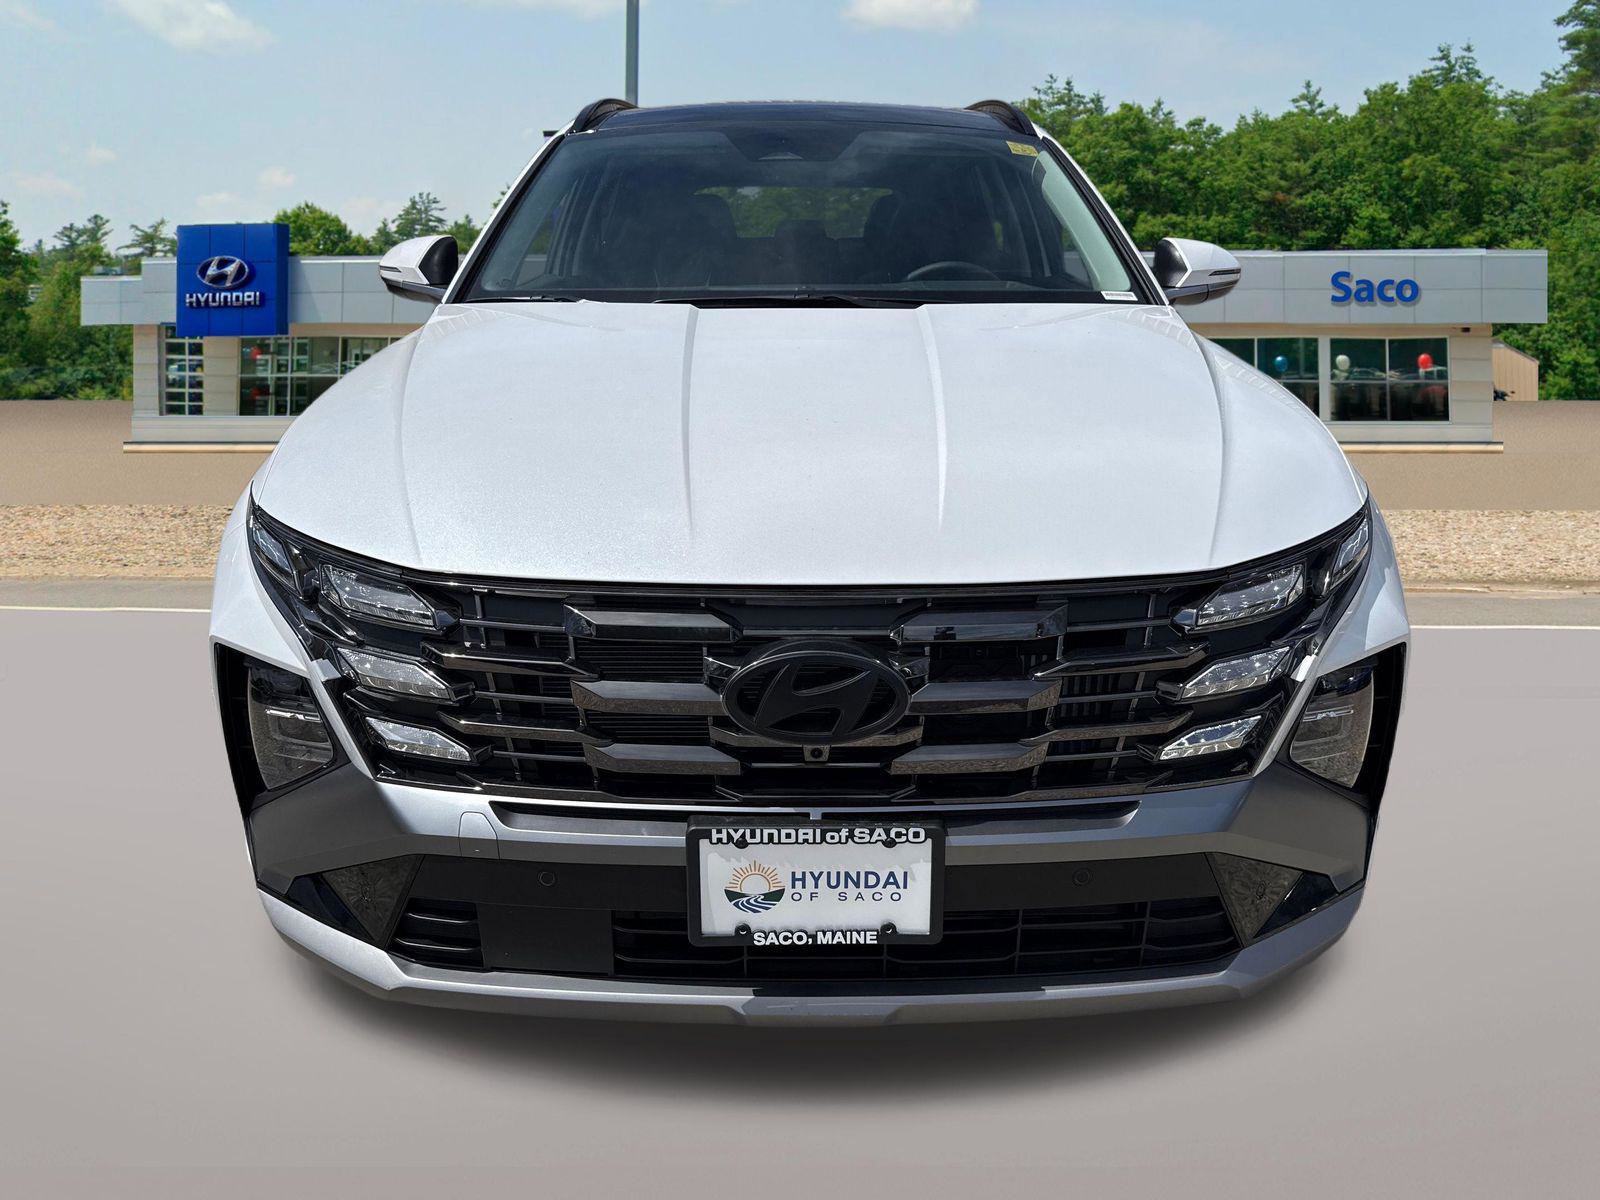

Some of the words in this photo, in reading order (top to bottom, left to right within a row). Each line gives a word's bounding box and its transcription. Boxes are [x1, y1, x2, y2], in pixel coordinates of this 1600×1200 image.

[1331, 271, 1419, 303] Saco
[185, 291, 260, 308] HYUNDAI
[711, 828, 821, 844] HYUNDAI
[825, 828, 849, 844] of
[853, 827, 926, 844] SACO
[791, 871, 908, 890] HYUNDAI
[791, 891, 819, 902] OF
[838, 891, 902, 902] SACO
[753, 931, 813, 945] SACO,
[817, 931, 878, 944] MAINE
